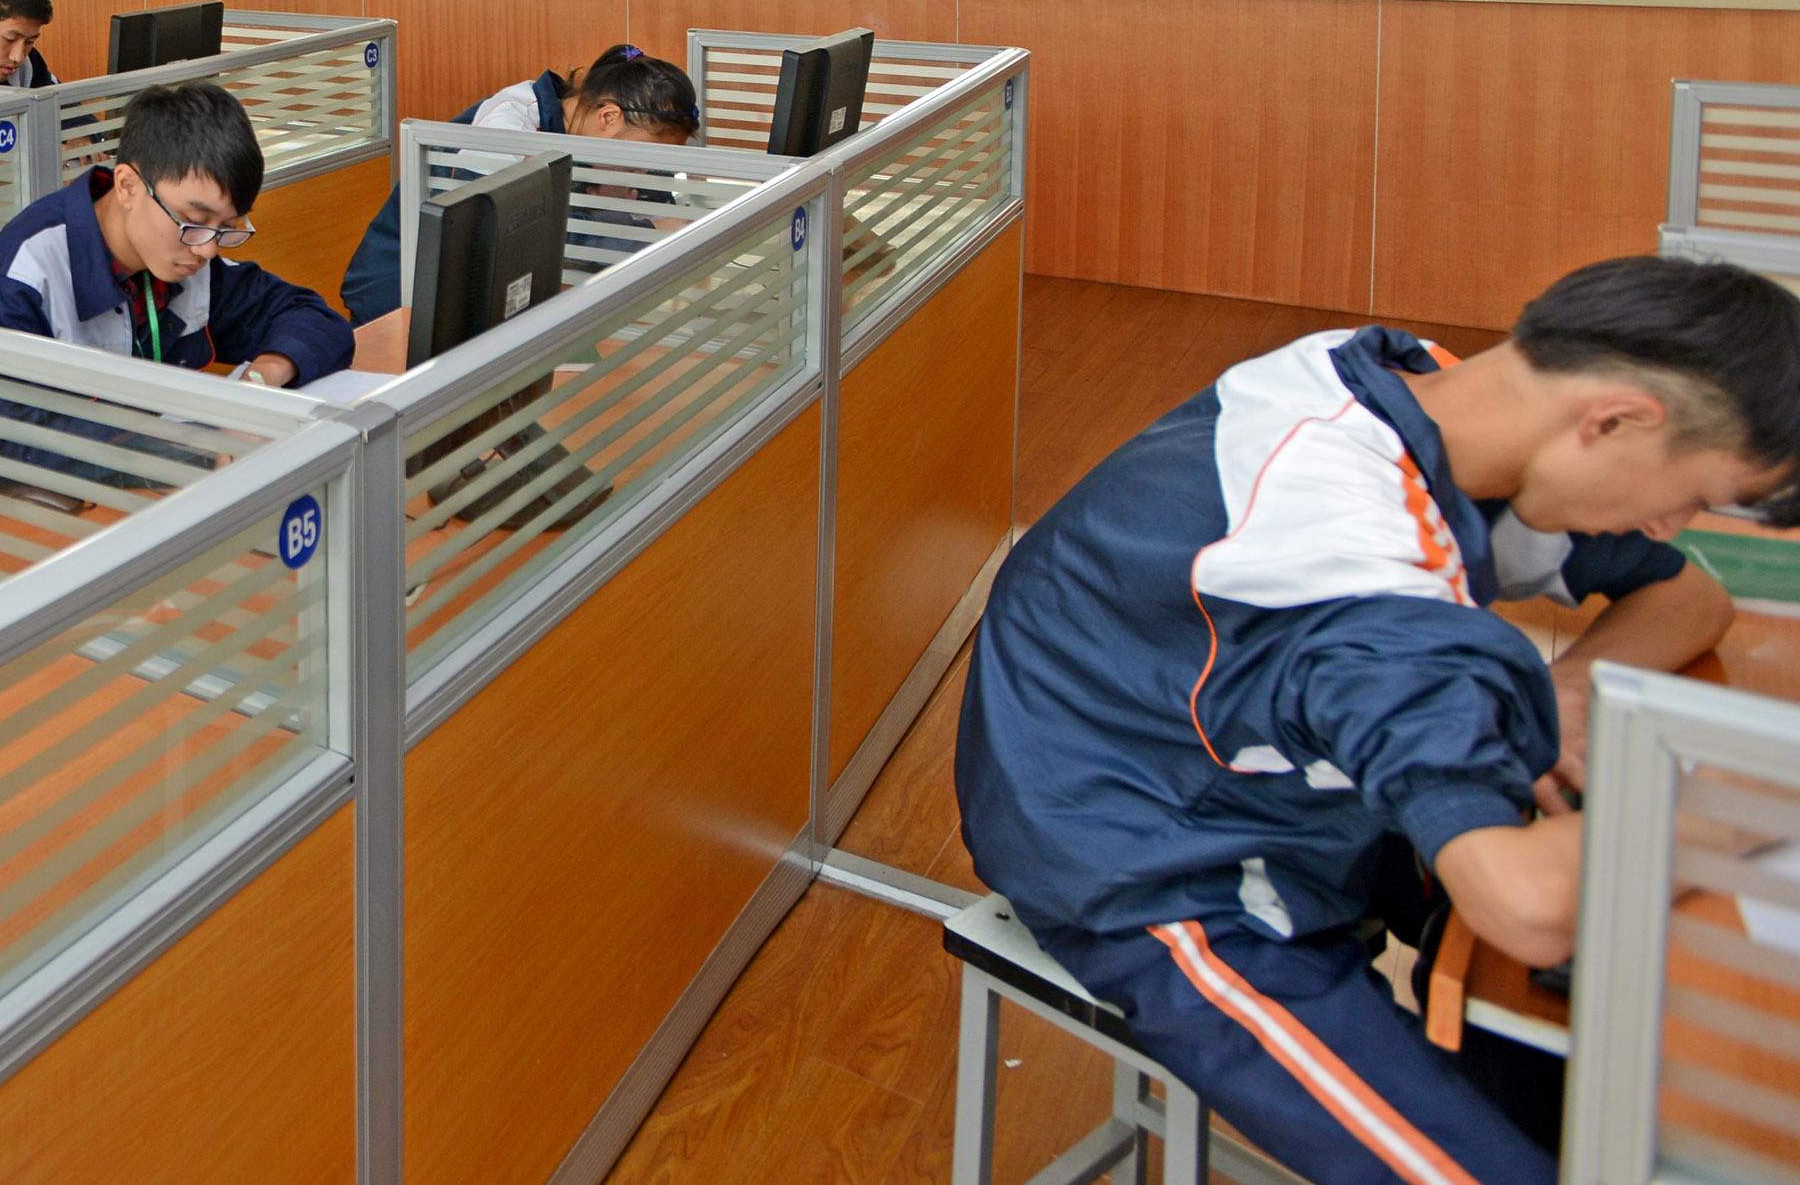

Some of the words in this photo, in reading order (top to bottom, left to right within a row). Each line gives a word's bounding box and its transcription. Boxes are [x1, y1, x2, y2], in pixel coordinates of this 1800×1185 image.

[367, 48, 378, 62] C3
[795, 218, 806, 243] B4
[287, 509, 317, 560] B5
